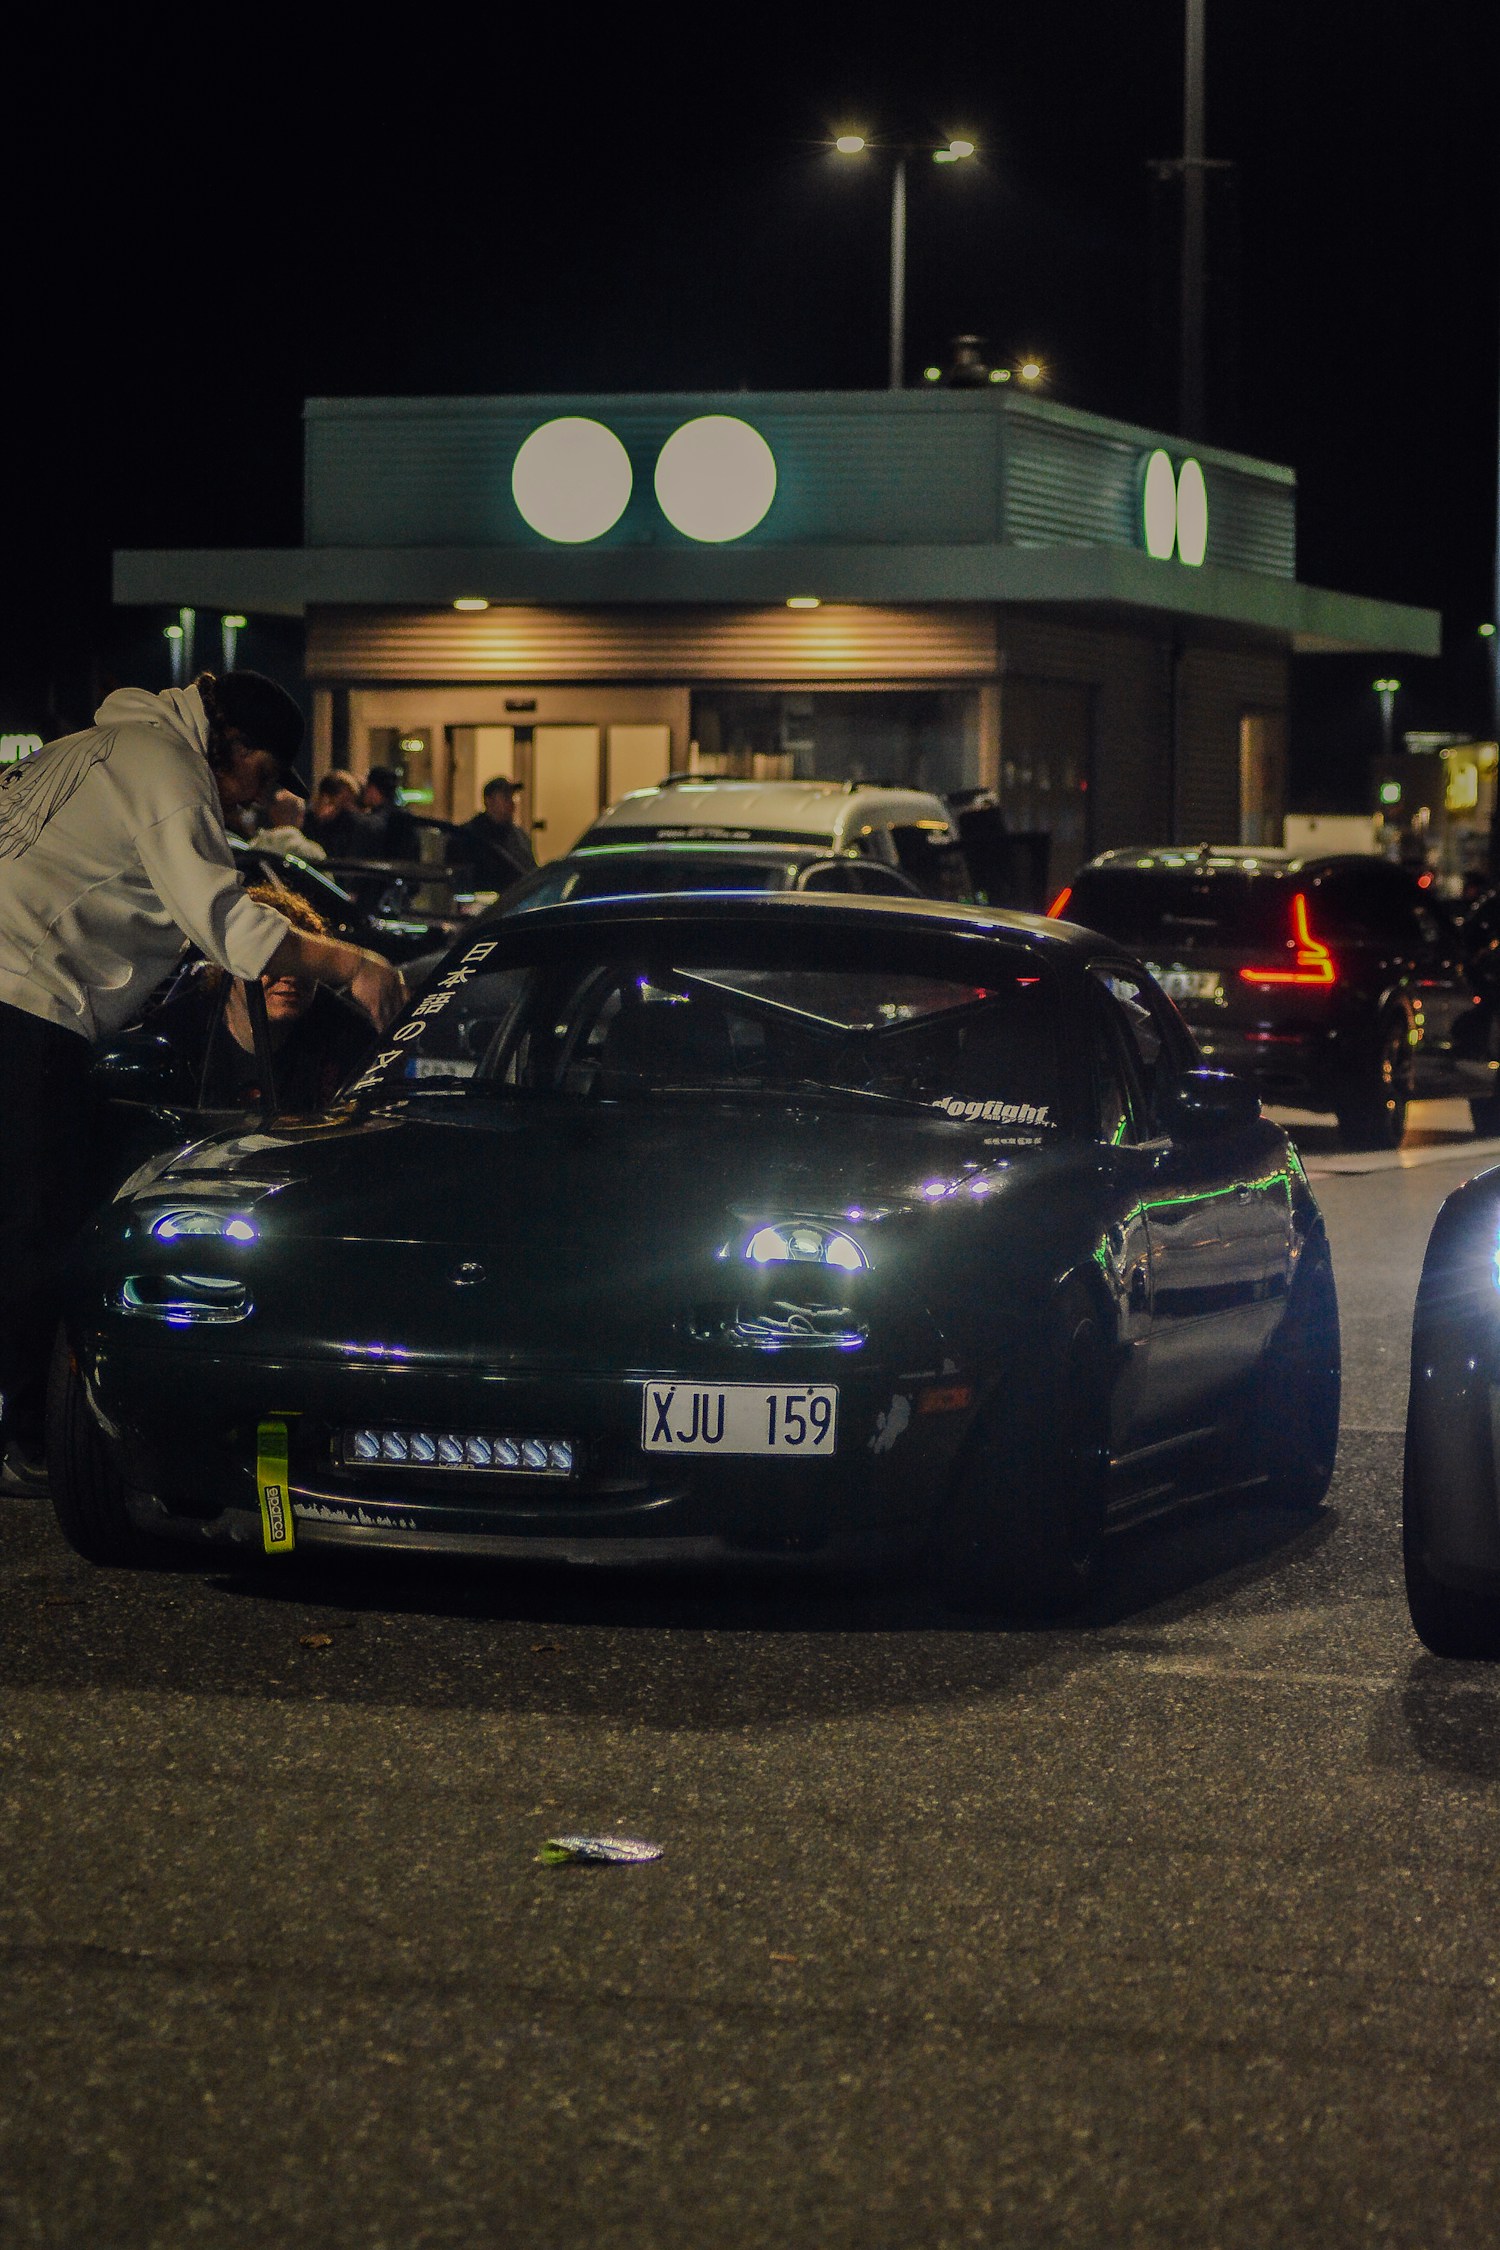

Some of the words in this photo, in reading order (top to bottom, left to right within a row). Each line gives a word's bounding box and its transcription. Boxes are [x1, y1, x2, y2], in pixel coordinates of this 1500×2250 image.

[932, 1096, 1049, 1124] dogfight
[651, 1391, 725, 1443] XJU
[765, 1395, 831, 1445] 159
